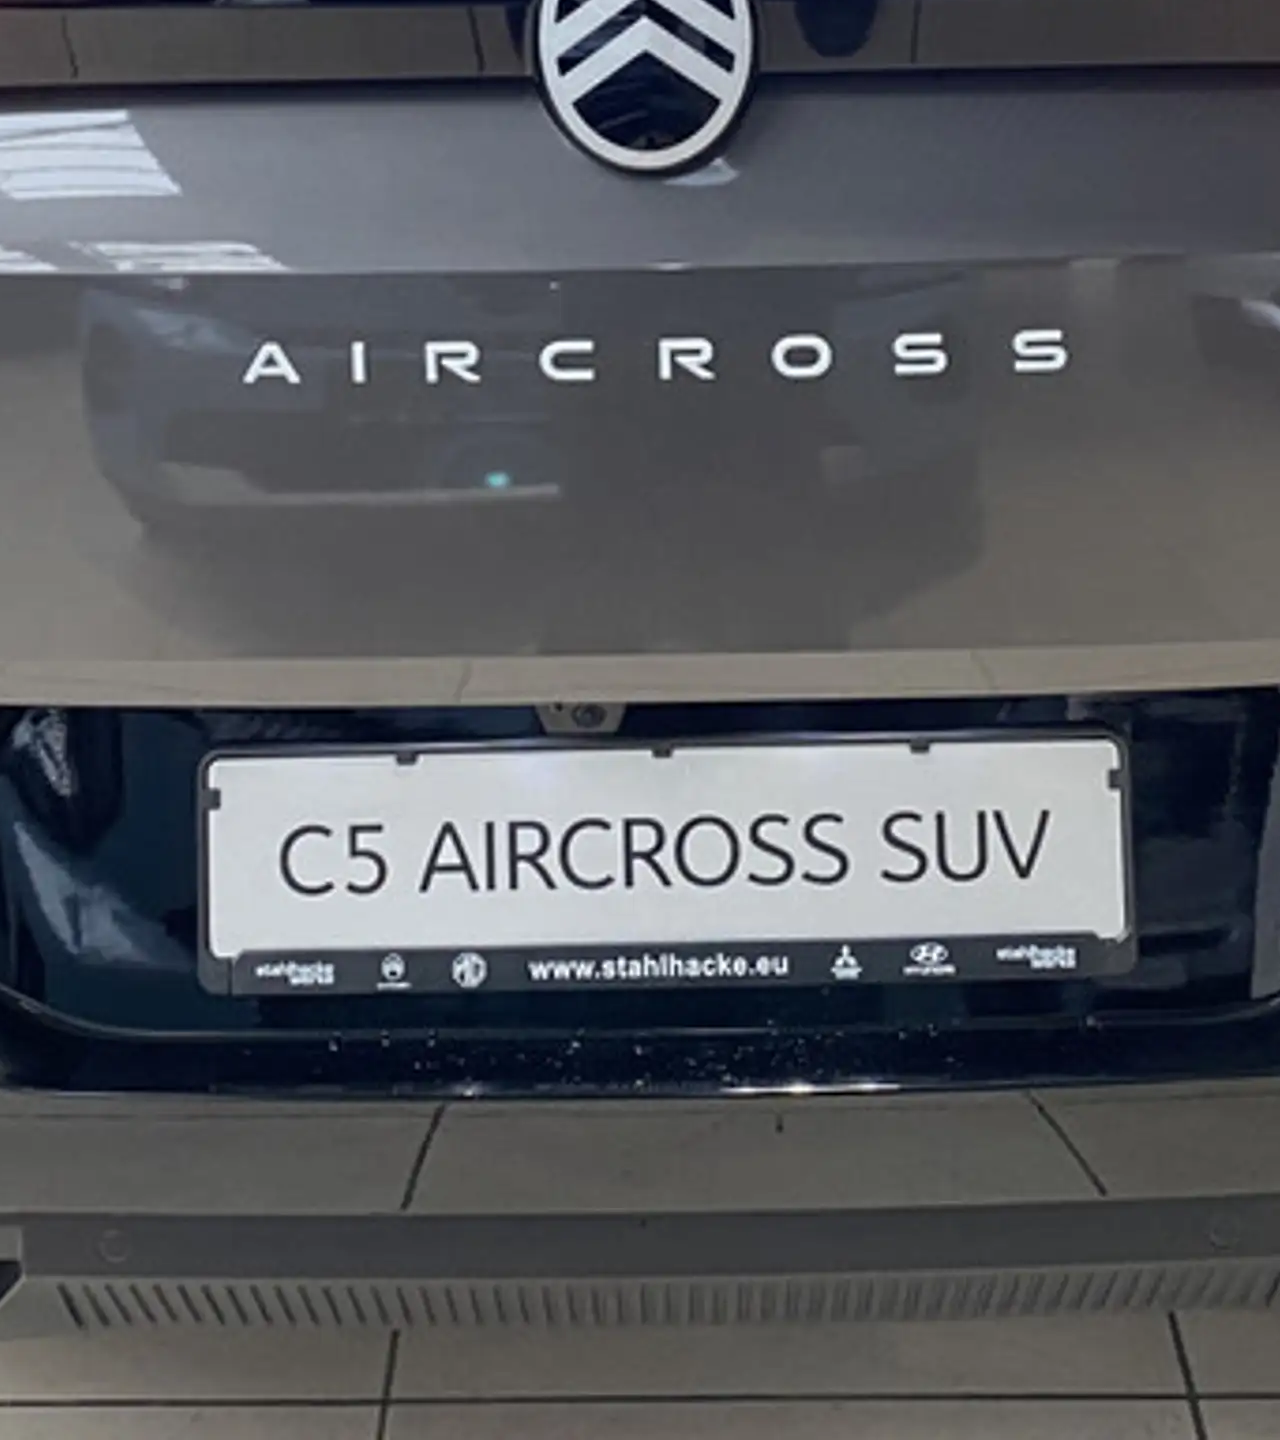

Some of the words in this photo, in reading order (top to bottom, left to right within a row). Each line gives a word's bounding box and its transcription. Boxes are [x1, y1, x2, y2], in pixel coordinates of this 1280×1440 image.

[242, 328, 1068, 385] AIRCROSS
[280, 823, 388, 896] C5
[419, 813, 849, 893] AIRCROSS
[881, 809, 1050, 883] SUV
[527, 952, 790, 982] www.stahlhacke.eu
